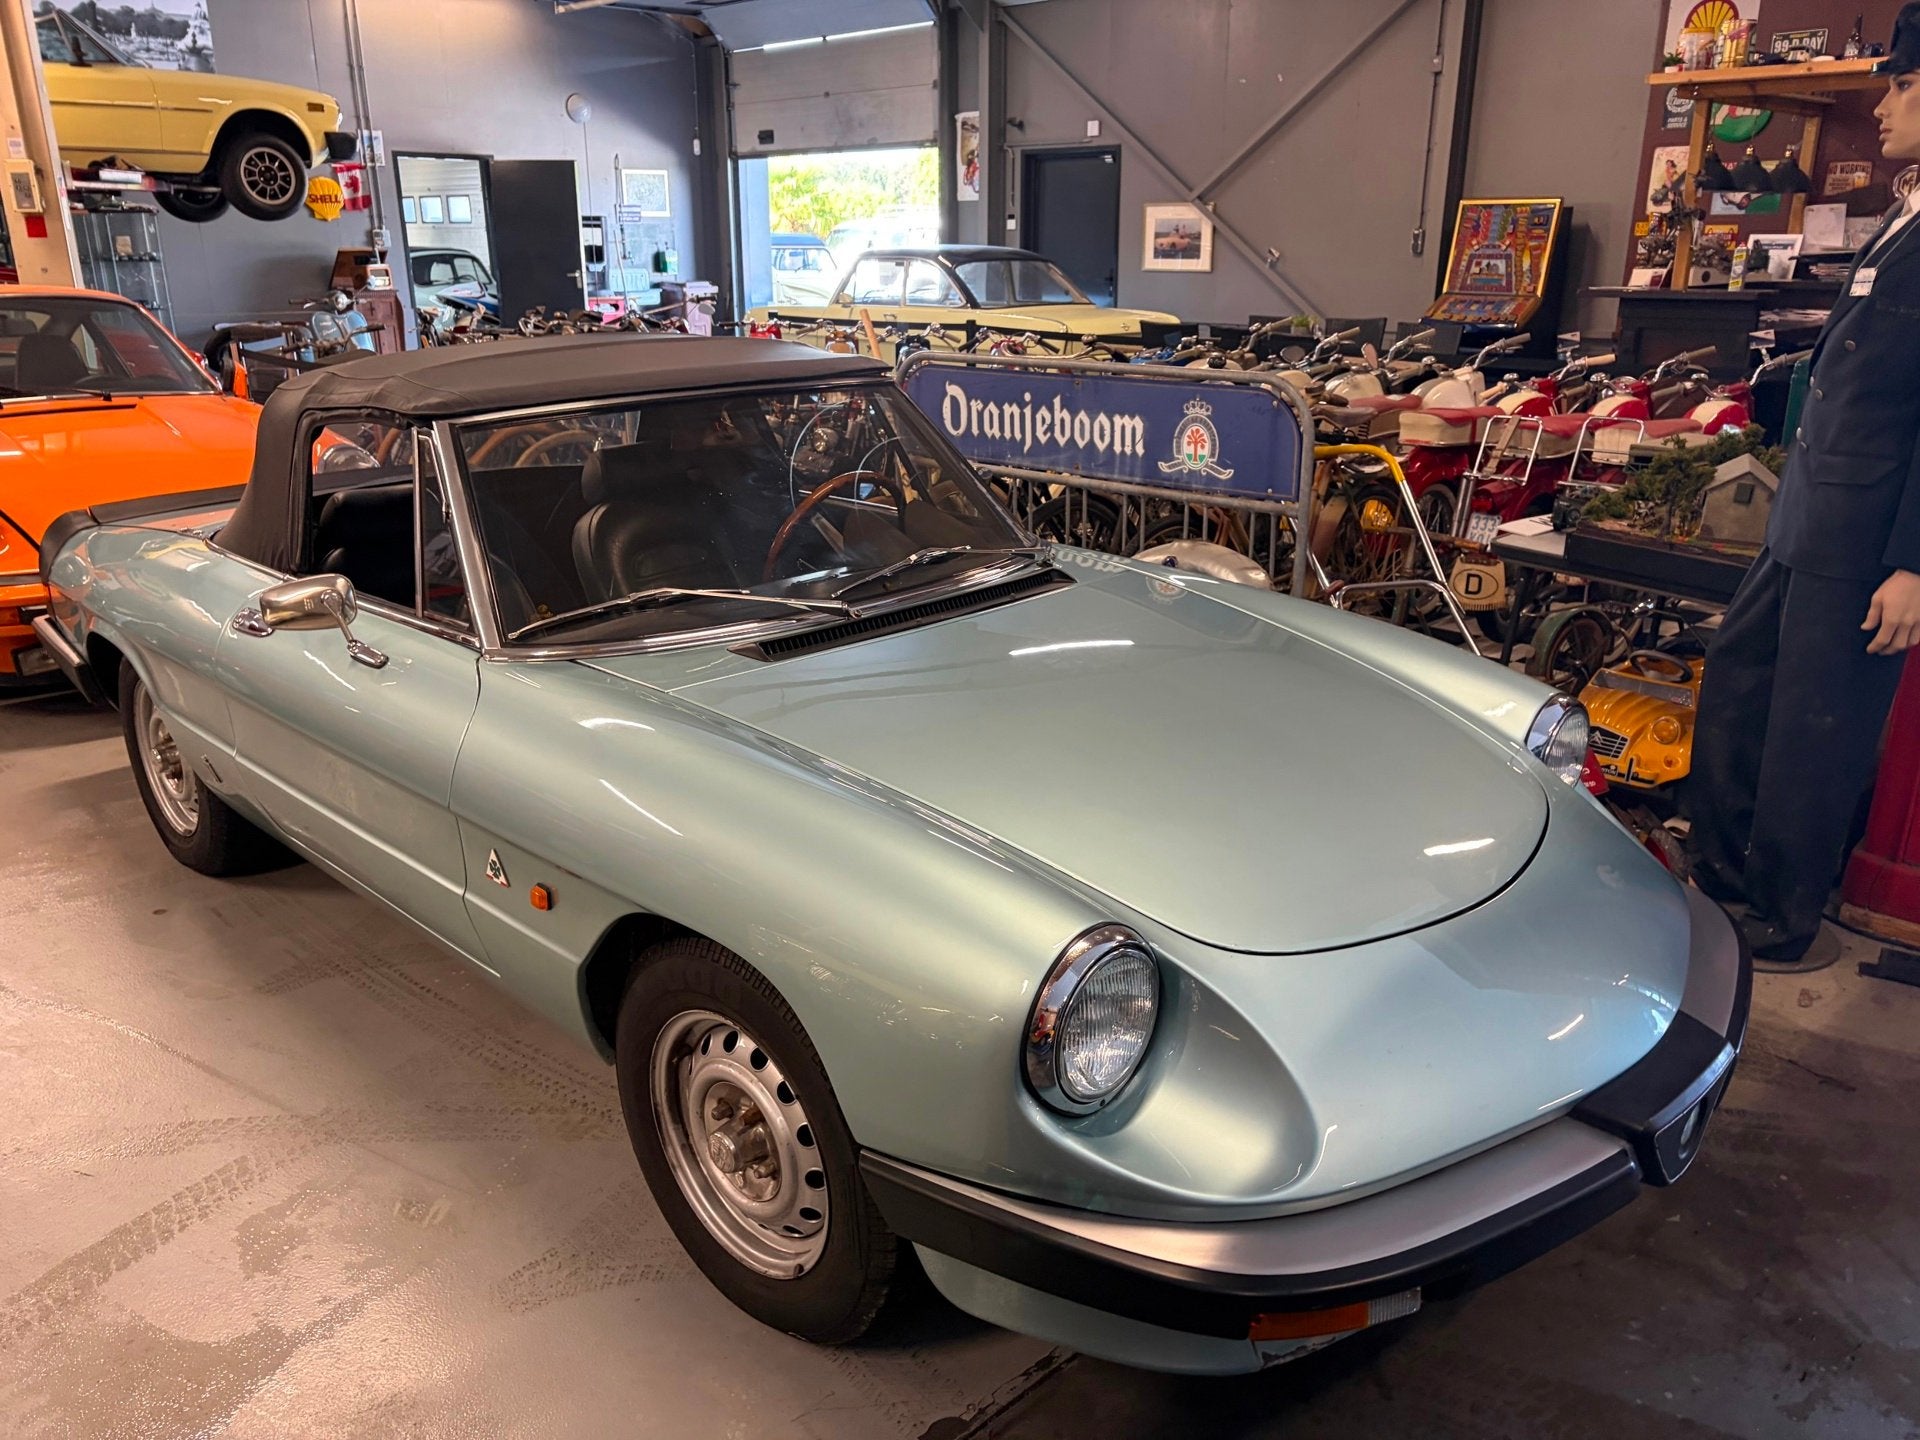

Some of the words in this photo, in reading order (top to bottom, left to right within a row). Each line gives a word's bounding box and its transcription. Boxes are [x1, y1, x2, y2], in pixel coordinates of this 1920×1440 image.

[309, 194, 341, 204] SHELL
[942, 381, 1146, 458] Oranjeboom
[1472, 515, 1497, 532] 333
[1464, 573, 1482, 595] D
